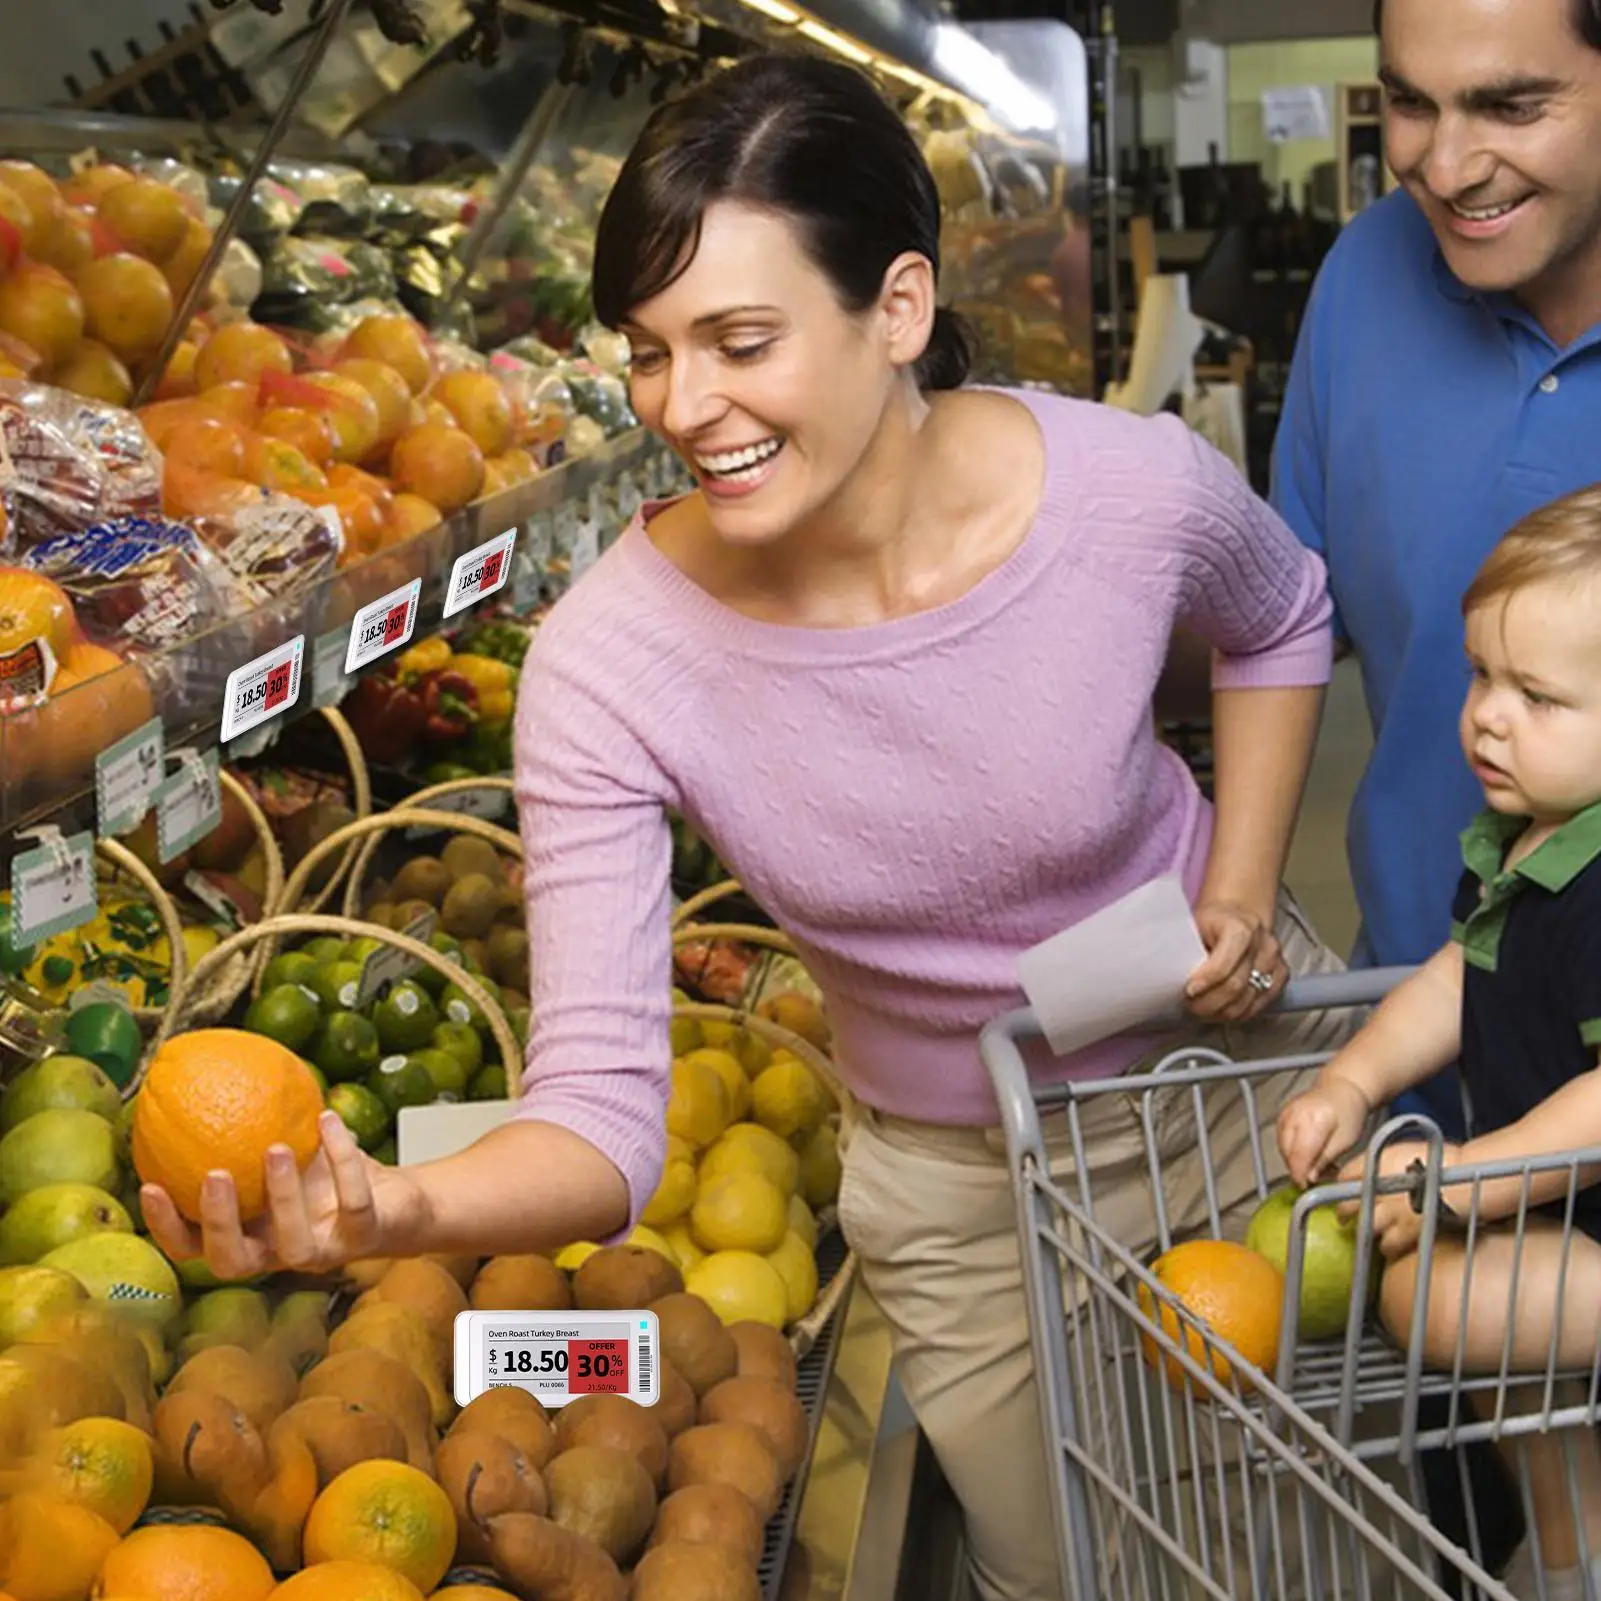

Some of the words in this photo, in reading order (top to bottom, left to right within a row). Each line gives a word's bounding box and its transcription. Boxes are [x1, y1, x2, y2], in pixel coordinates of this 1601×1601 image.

[364, 619, 388, 643] 18.50
[387, 616, 400, 633] 30
[241, 681, 268, 709] 18.50
[269, 676, 283, 697] 30
[531, 1330, 555, 1338] Turkey
[488, 1367, 498, 1375] Kg
[489, 1348, 497, 1362] $
[504, 1350, 569, 1373] 18.50
